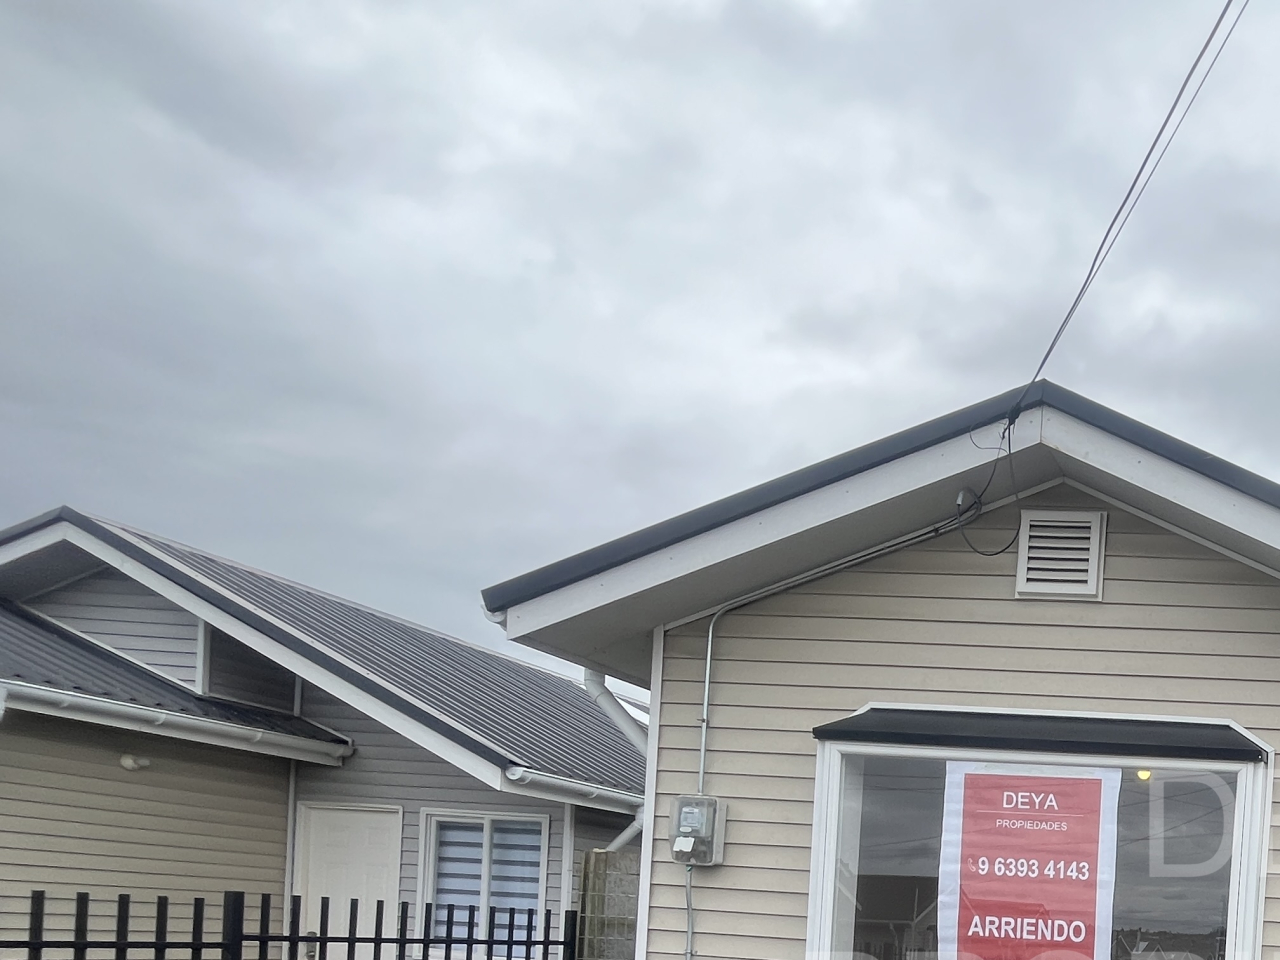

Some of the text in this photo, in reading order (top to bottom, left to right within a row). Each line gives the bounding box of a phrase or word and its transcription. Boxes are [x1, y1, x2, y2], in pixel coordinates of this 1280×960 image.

[1002, 791, 1059, 810] DEYA
[996, 819, 1068, 831] PROPIEDADES
[977, 857, 1090, 880] 9 6393 4143
[967, 915, 1086, 943] ARRIENDO
